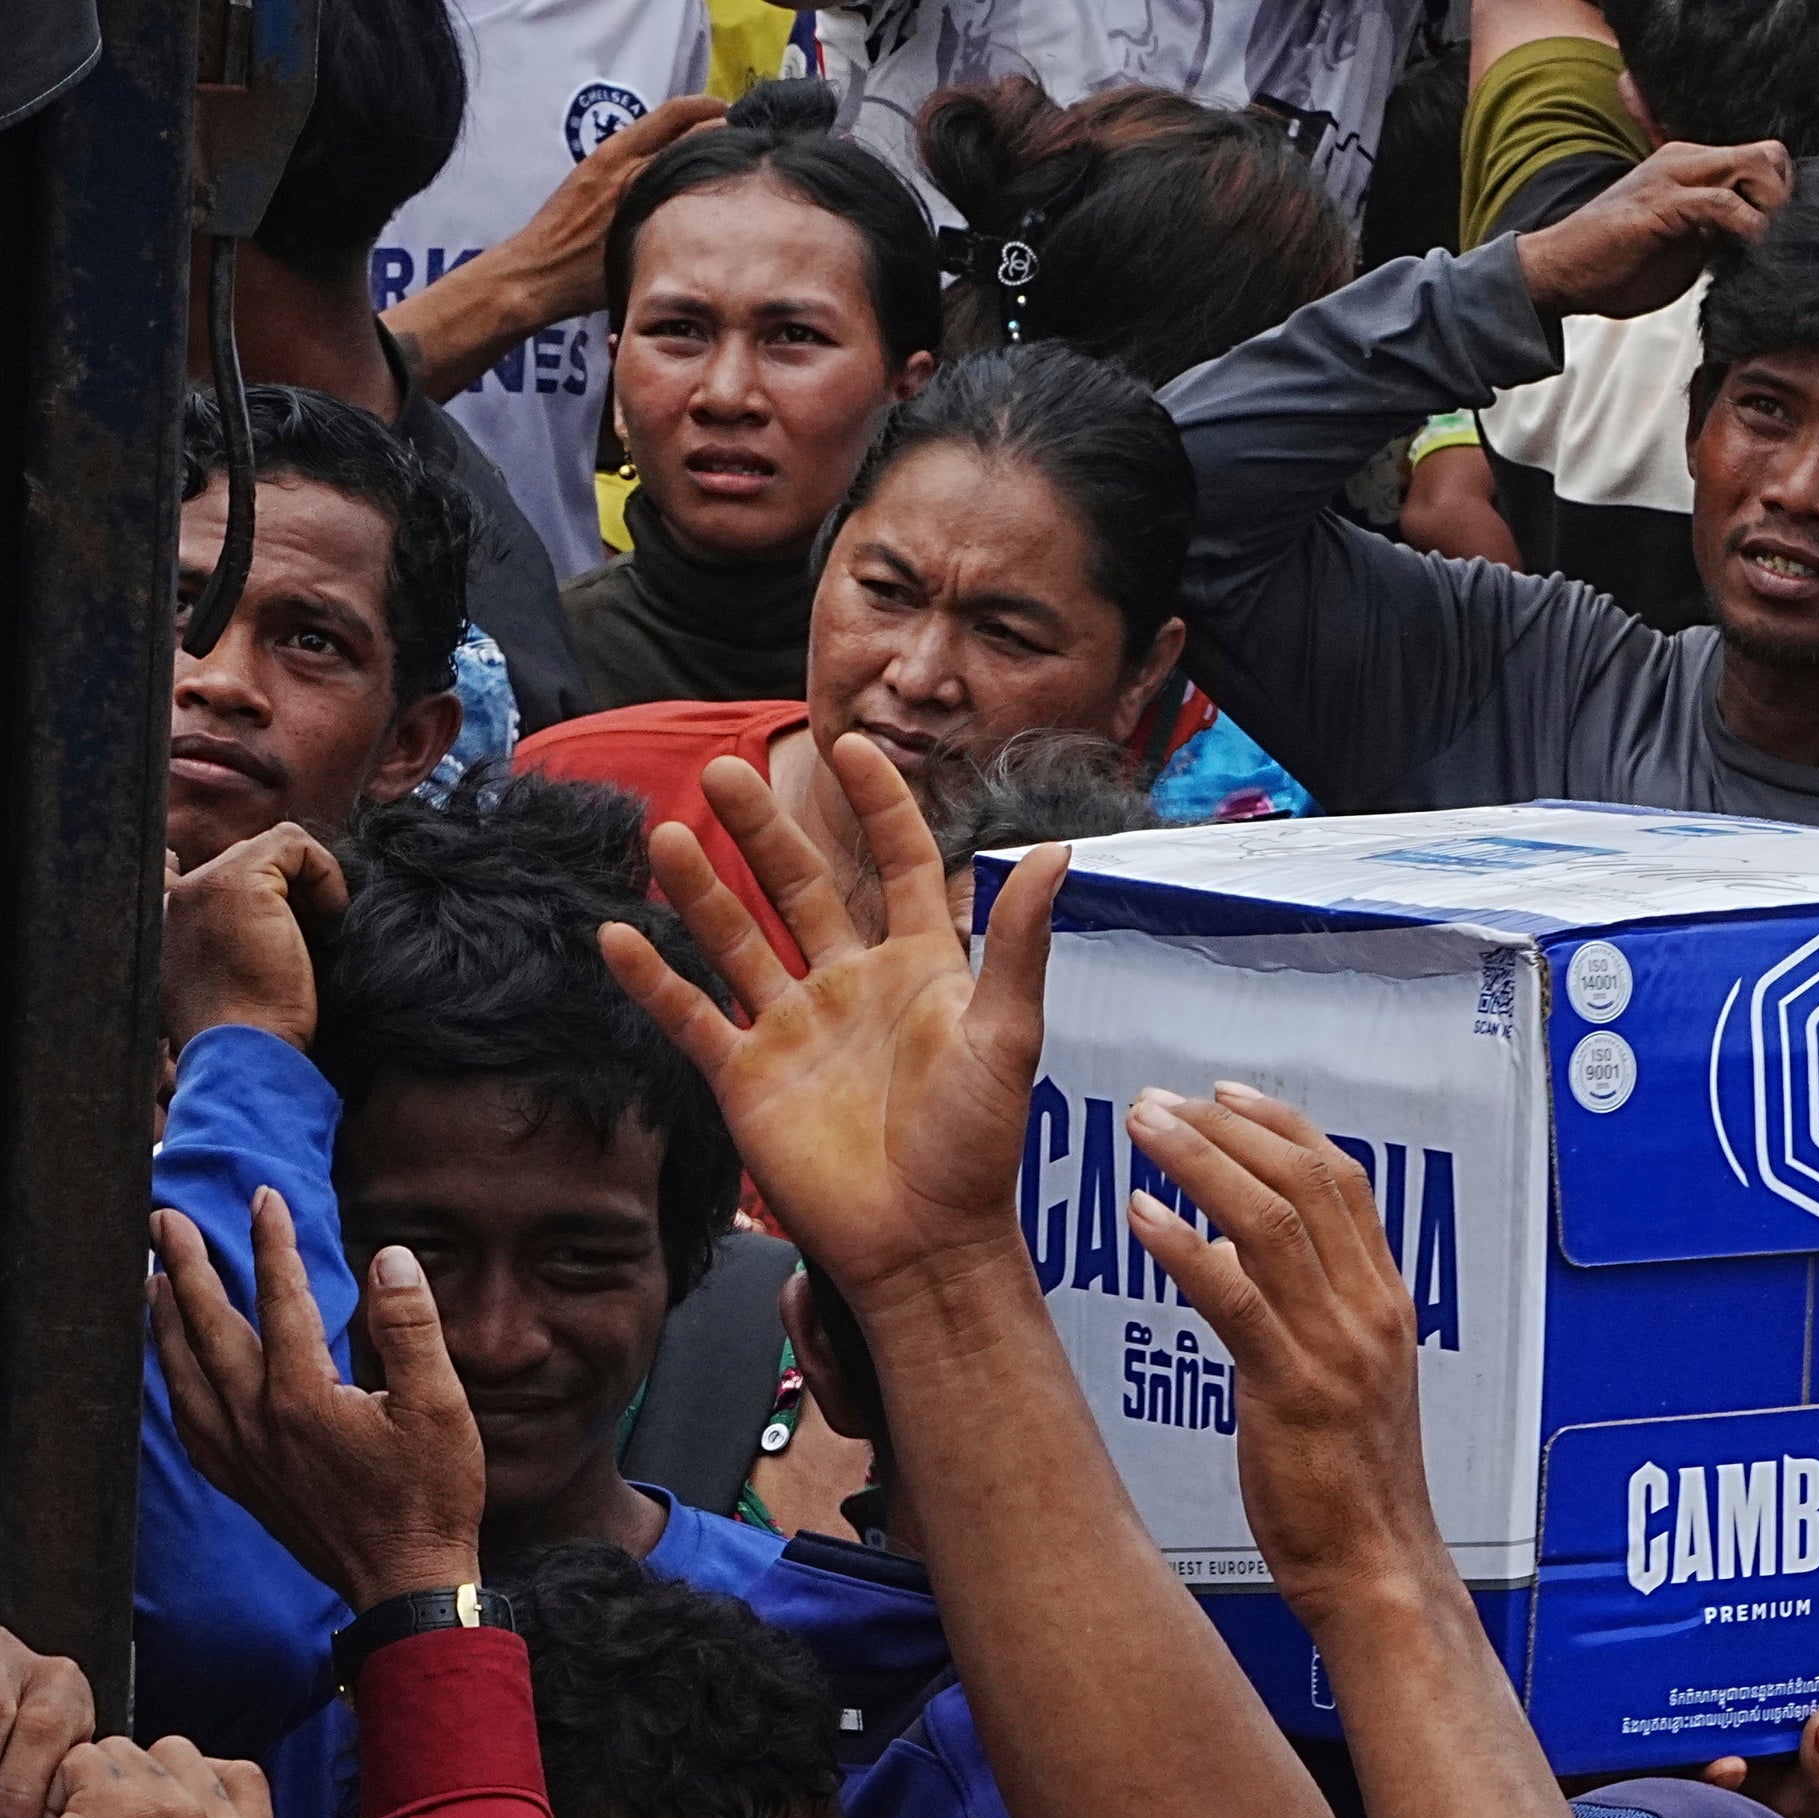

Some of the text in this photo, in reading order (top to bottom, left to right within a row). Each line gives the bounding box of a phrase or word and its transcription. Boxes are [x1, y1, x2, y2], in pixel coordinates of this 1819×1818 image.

[578, 89, 640, 116] CHELSEA
[1588, 959, 1608, 973] ISO
[1580, 974, 1619, 991] 14001
[1473, 1019, 1498, 1037] SCAN
[1591, 1048, 1612, 1062] ISO
[1585, 1064, 1619, 1081] 9001
[1704, 1598, 1812, 1626] PREMIUM
